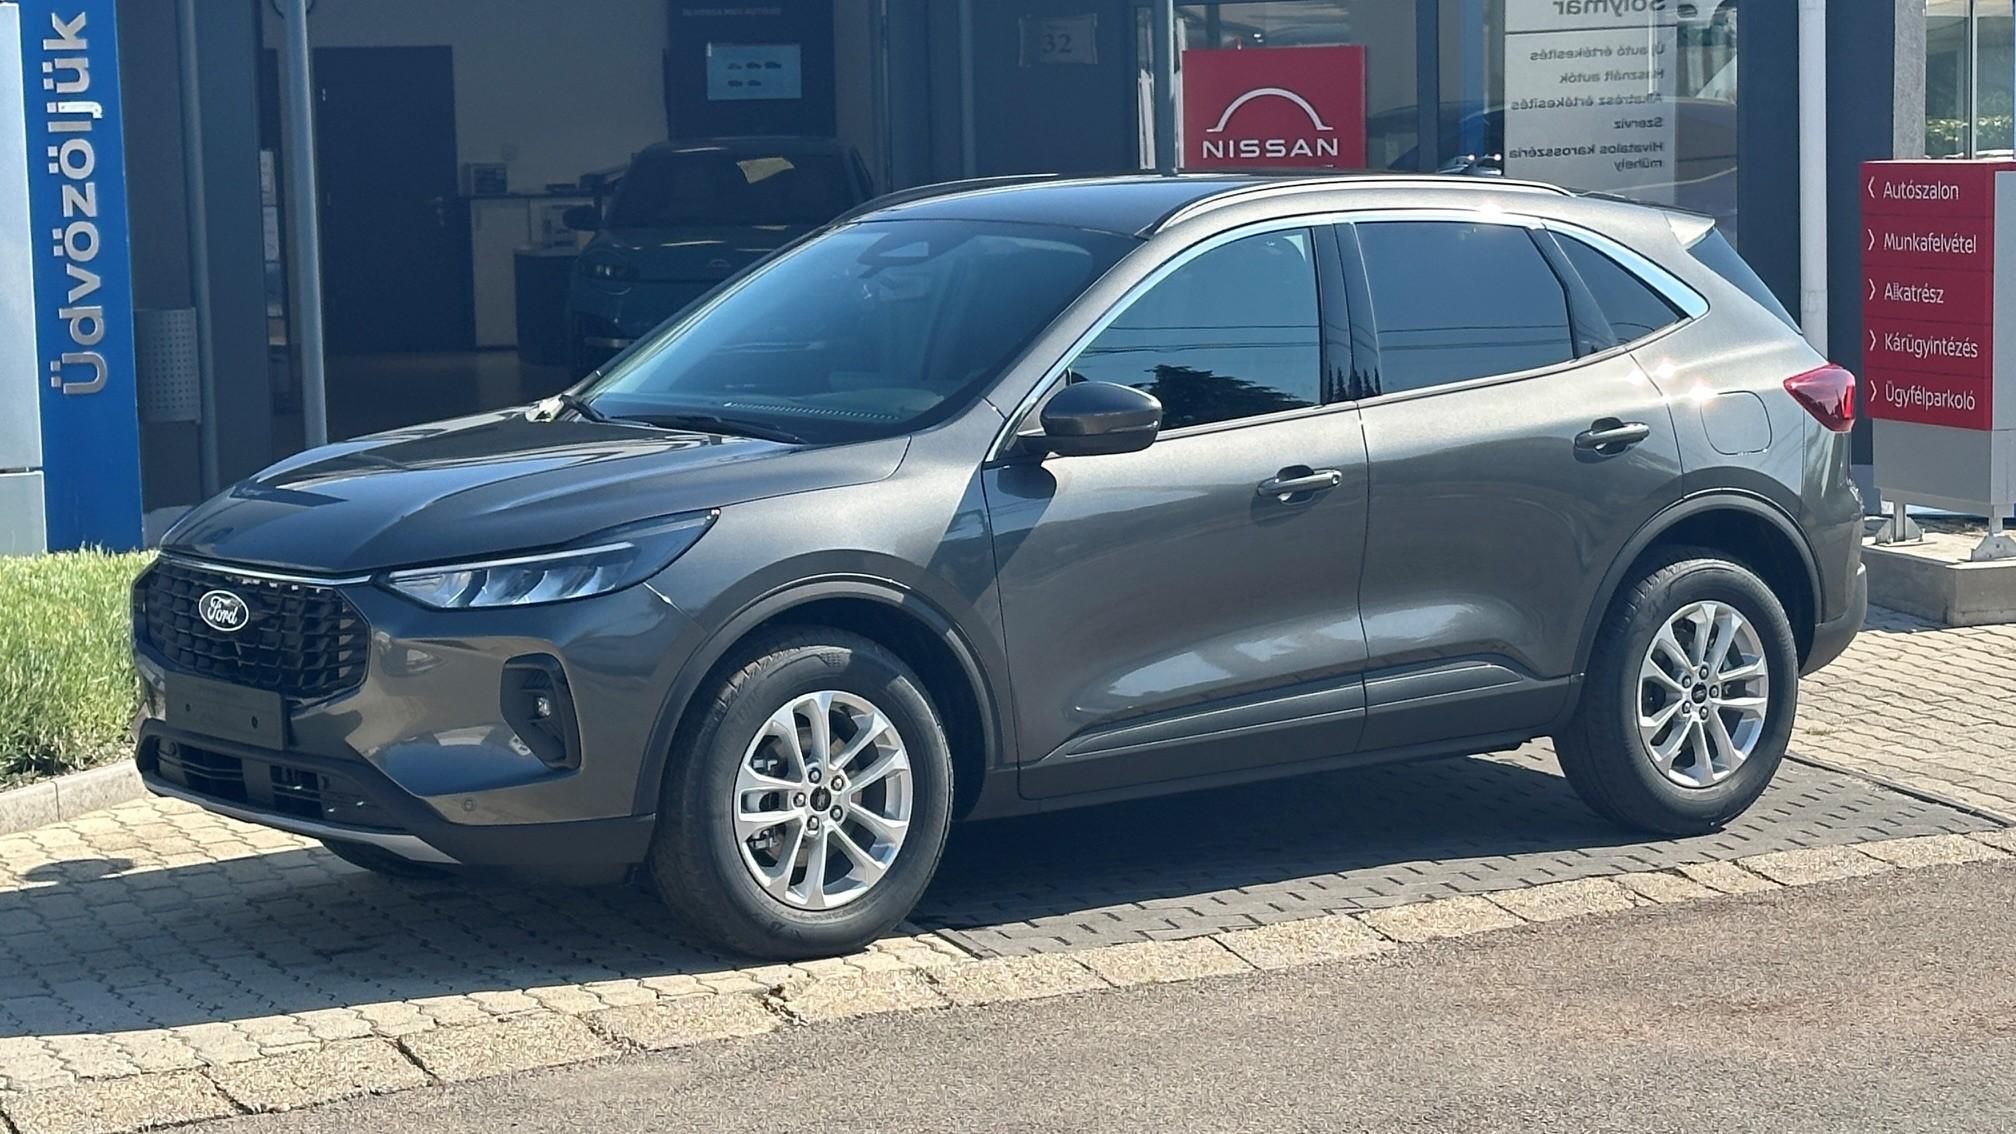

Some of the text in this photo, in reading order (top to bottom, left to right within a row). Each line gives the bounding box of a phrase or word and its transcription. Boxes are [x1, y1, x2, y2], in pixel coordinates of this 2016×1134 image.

[1042, 33, 1072, 54] 32
[1202, 138, 1339, 159] NISSAN
[1883, 179, 1960, 201] Autószalon
[42, 11, 108, 396] Üdvözöljük
[1884, 231, 1978, 254] Munkafelvétel
[1884, 282, 1945, 304] Alkatrész
[1884, 332, 1979, 359] Kárügyintézés
[1885, 380, 1976, 411] Ügyfélparkoló
[207, 595, 239, 625] Ford
